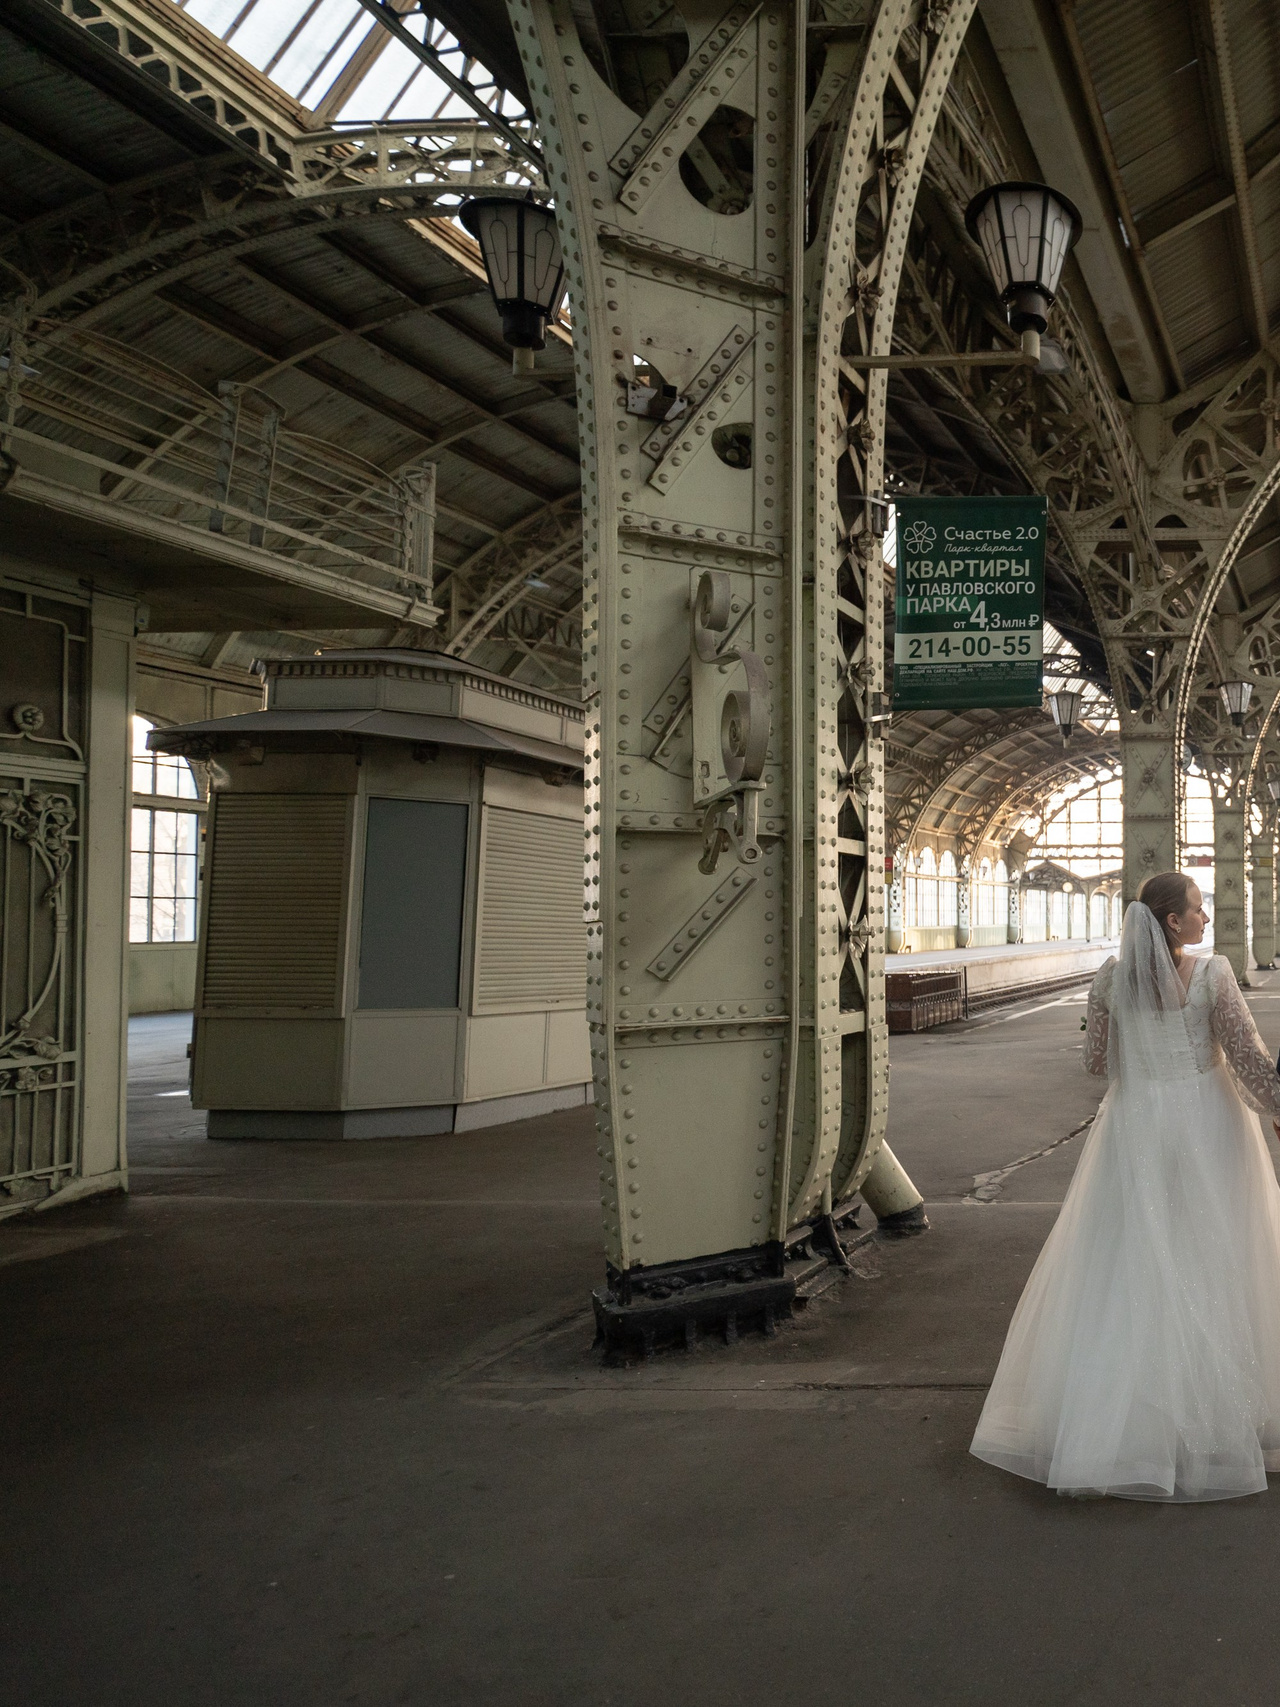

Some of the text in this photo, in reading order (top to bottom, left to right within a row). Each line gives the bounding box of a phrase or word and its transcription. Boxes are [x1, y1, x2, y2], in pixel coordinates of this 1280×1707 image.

[944, 526, 1039, 541] Счастье 2.0
[943, 543, 1023, 553] Парк-квартал
[906, 559, 1030, 579] КВАРТИРЫ
[919, 581, 1036, 596] ПАВЛОВСКОГО
[906, 597, 972, 614] ПАРКА
[953, 620, 966, 630] от
[969, 600, 1001, 632] 4,3
[1002, 619, 1026, 629] млн
[908, 635, 1031, 659] 214-00-55
